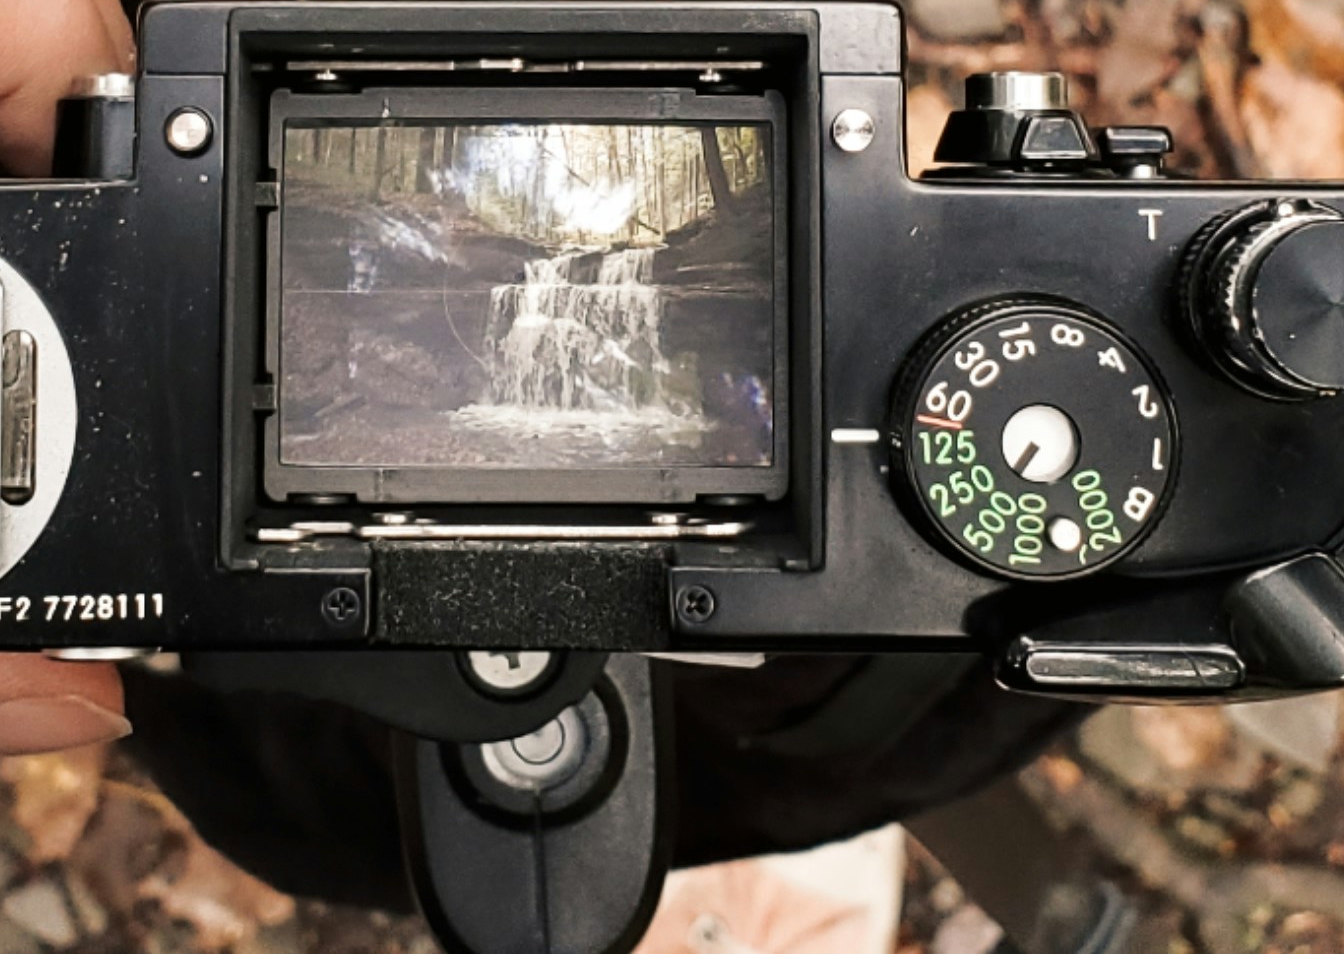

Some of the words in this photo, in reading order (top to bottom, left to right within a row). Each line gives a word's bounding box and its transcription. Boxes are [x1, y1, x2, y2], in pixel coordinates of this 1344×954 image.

[1137, 209, 1164, 241] T
[998, 321, 1036, 361] 15
[1050, 323, 1084, 347] 8
[955, 341, 1000, 388] 30
[1096, 345, 1127, 374] 4
[925, 381, 973, 423] 60
[1131, 384, 1158, 418] 2
[919, 430, 977, 465] 125
[929, 464, 994, 517] 250
[1122, 486, 1155, 523] B
[962, 490, 1017, 553] 500
[1009, 492, 1048, 565] 1000
[1071, 469, 1123, 552] 2000
[43, 592, 164, 621] 7728111
